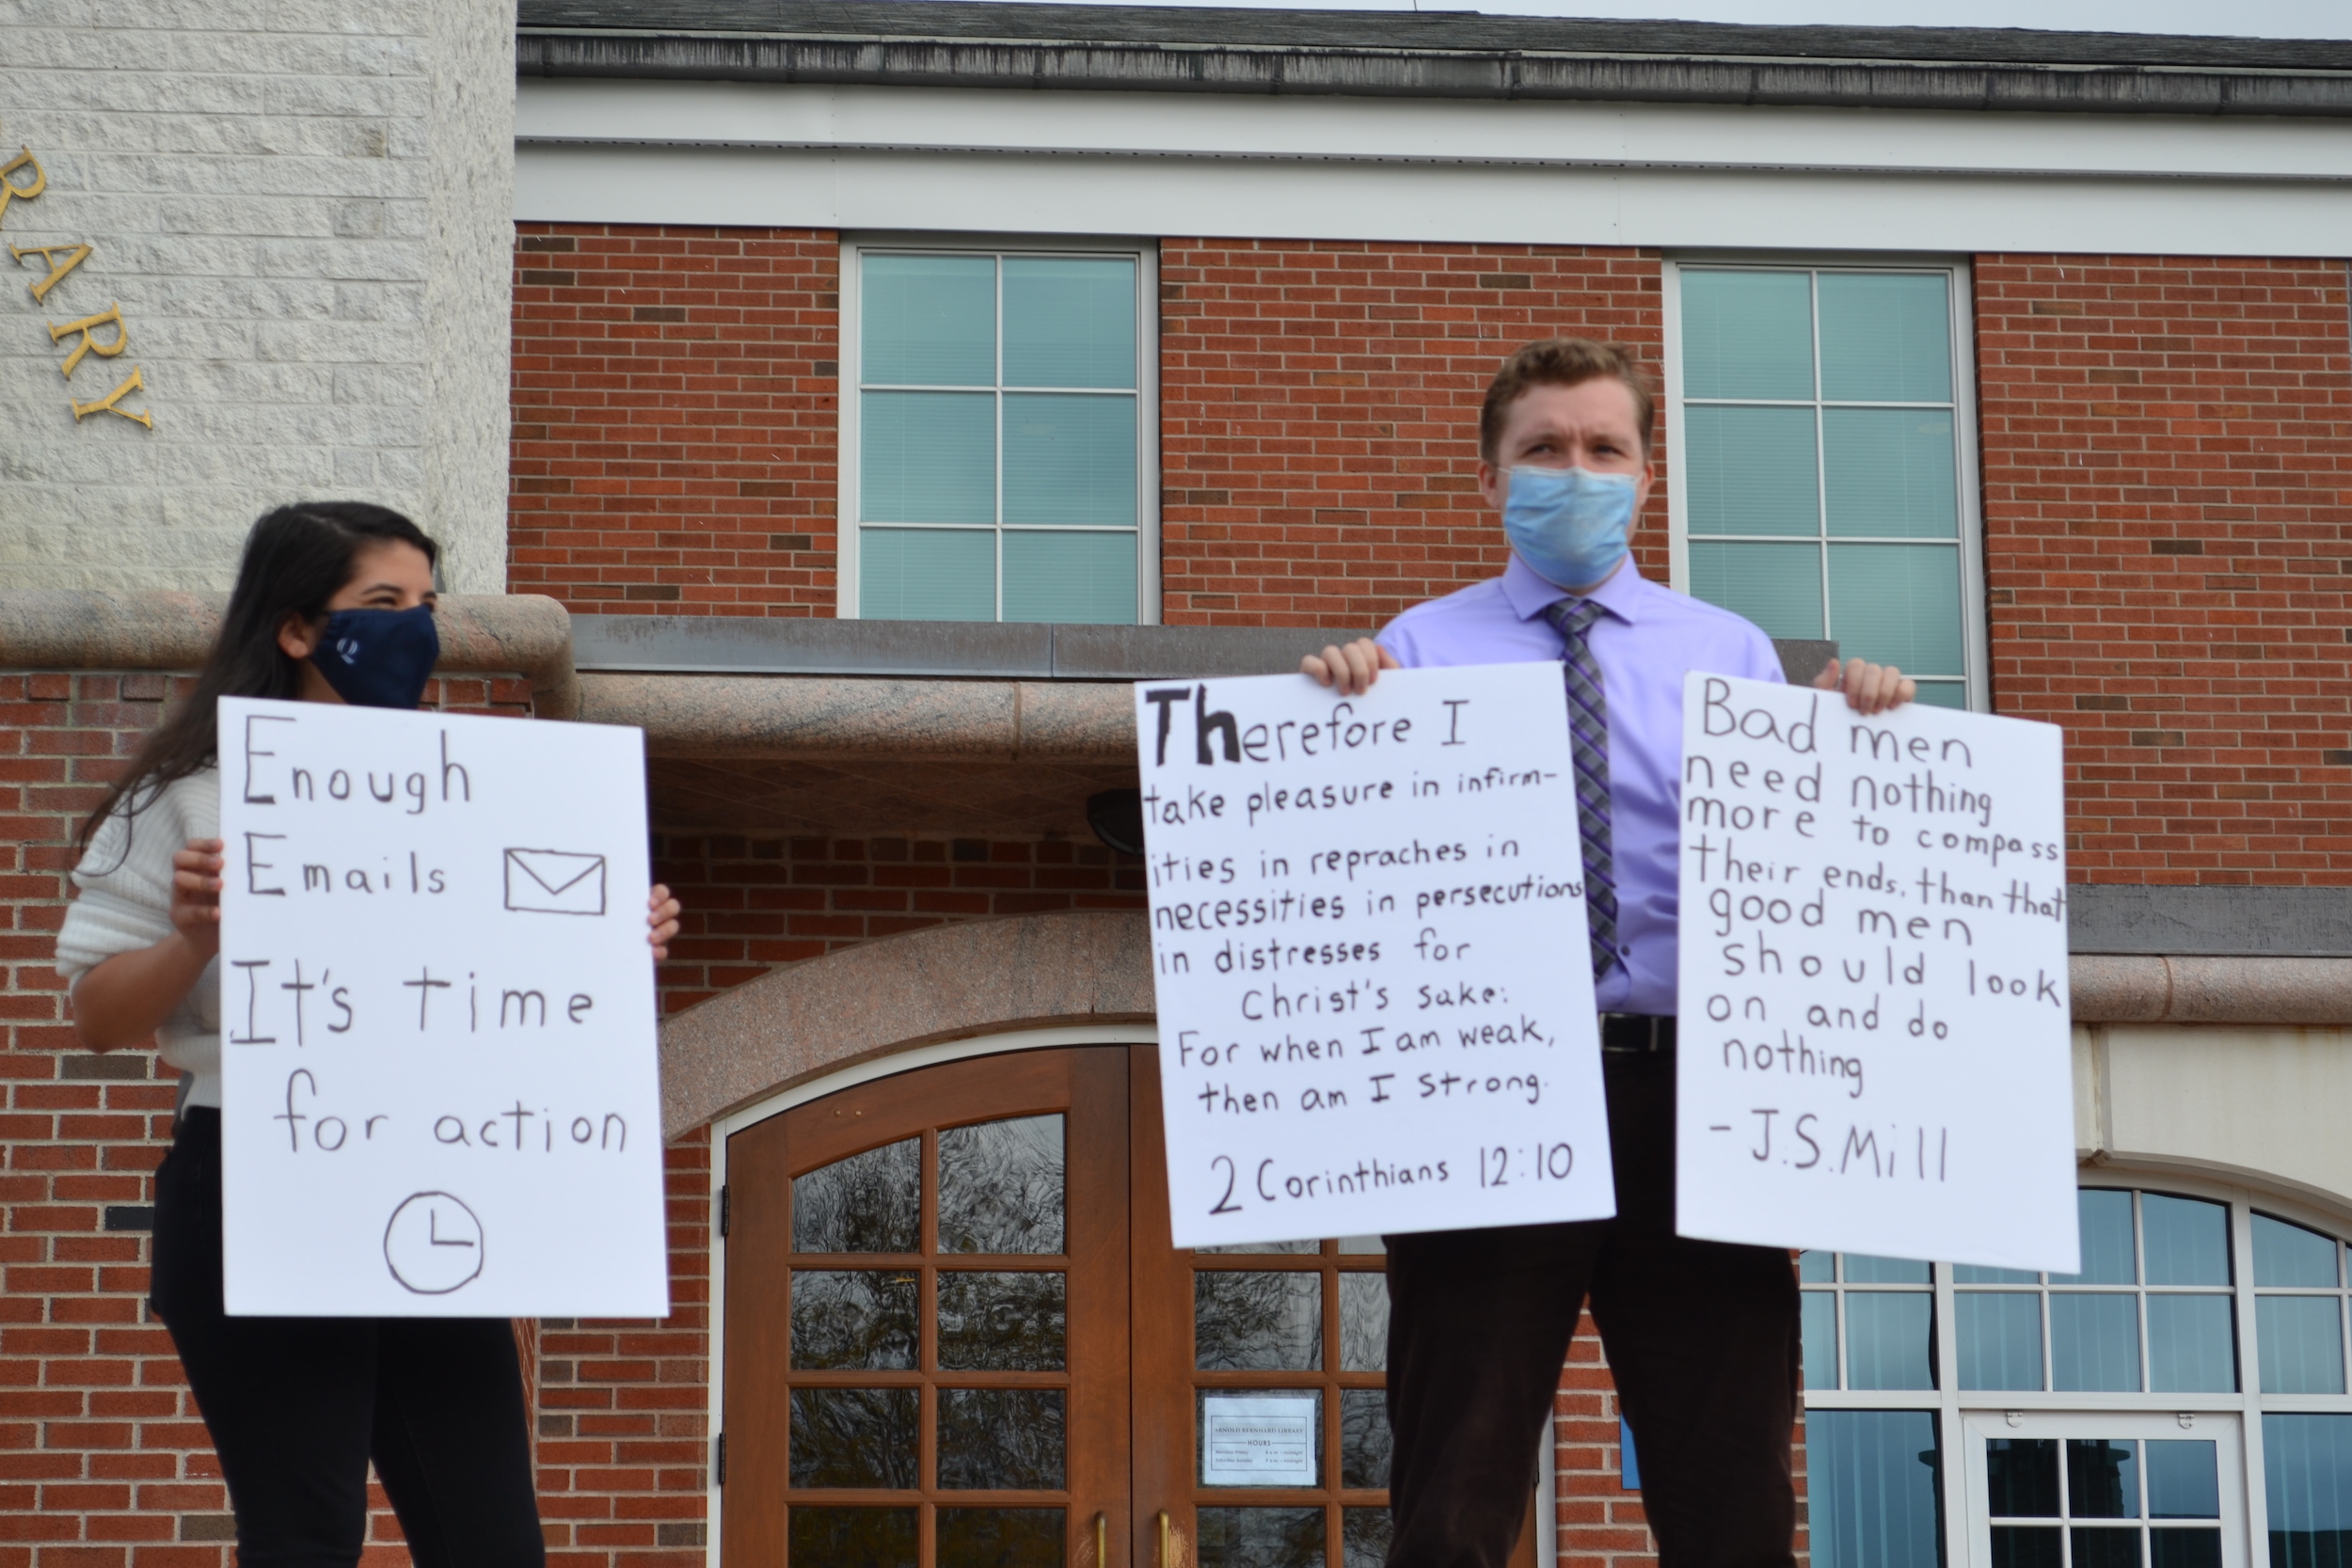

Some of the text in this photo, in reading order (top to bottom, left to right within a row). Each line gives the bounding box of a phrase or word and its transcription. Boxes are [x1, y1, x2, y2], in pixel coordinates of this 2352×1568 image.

[1144, 683, 1470, 768] Therefore I
[1703, 678, 1973, 769] Bad men
[243, 713, 471, 815] Enough
[1142, 766, 1559, 828] take pleasure in infirm-
[1686, 753, 1993, 829] need nothing
[243, 830, 447, 898] Emails
[1151, 832, 1521, 889] ities in repraches in
[1687, 796, 2059, 869] more to compass
[1154, 873, 1584, 933] necessities in persecutions
[1688, 832, 1801, 884] their
[1914, 864, 1995, 911] than
[2000, 879, 2068, 924] that
[1158, 926, 1472, 975] in distresses for
[1708, 886, 1974, 946] good men
[229, 958, 595, 1048] It's time
[1240, 977, 1511, 1022] Christ's sake:
[1721, 928, 2062, 1009] should look
[1176, 1013, 1557, 1069] For when I am weak,
[1705, 991, 1949, 1041] on and do
[1196, 1081, 1280, 1117] then
[1299, 1086, 1348, 1113] am
[1367, 1071, 1397, 1105] I
[1722, 1029, 1865, 1101] nothing
[272, 1067, 628, 1154] for action
[1207, 1140, 1576, 1217] 2 Corinthians 12:10
